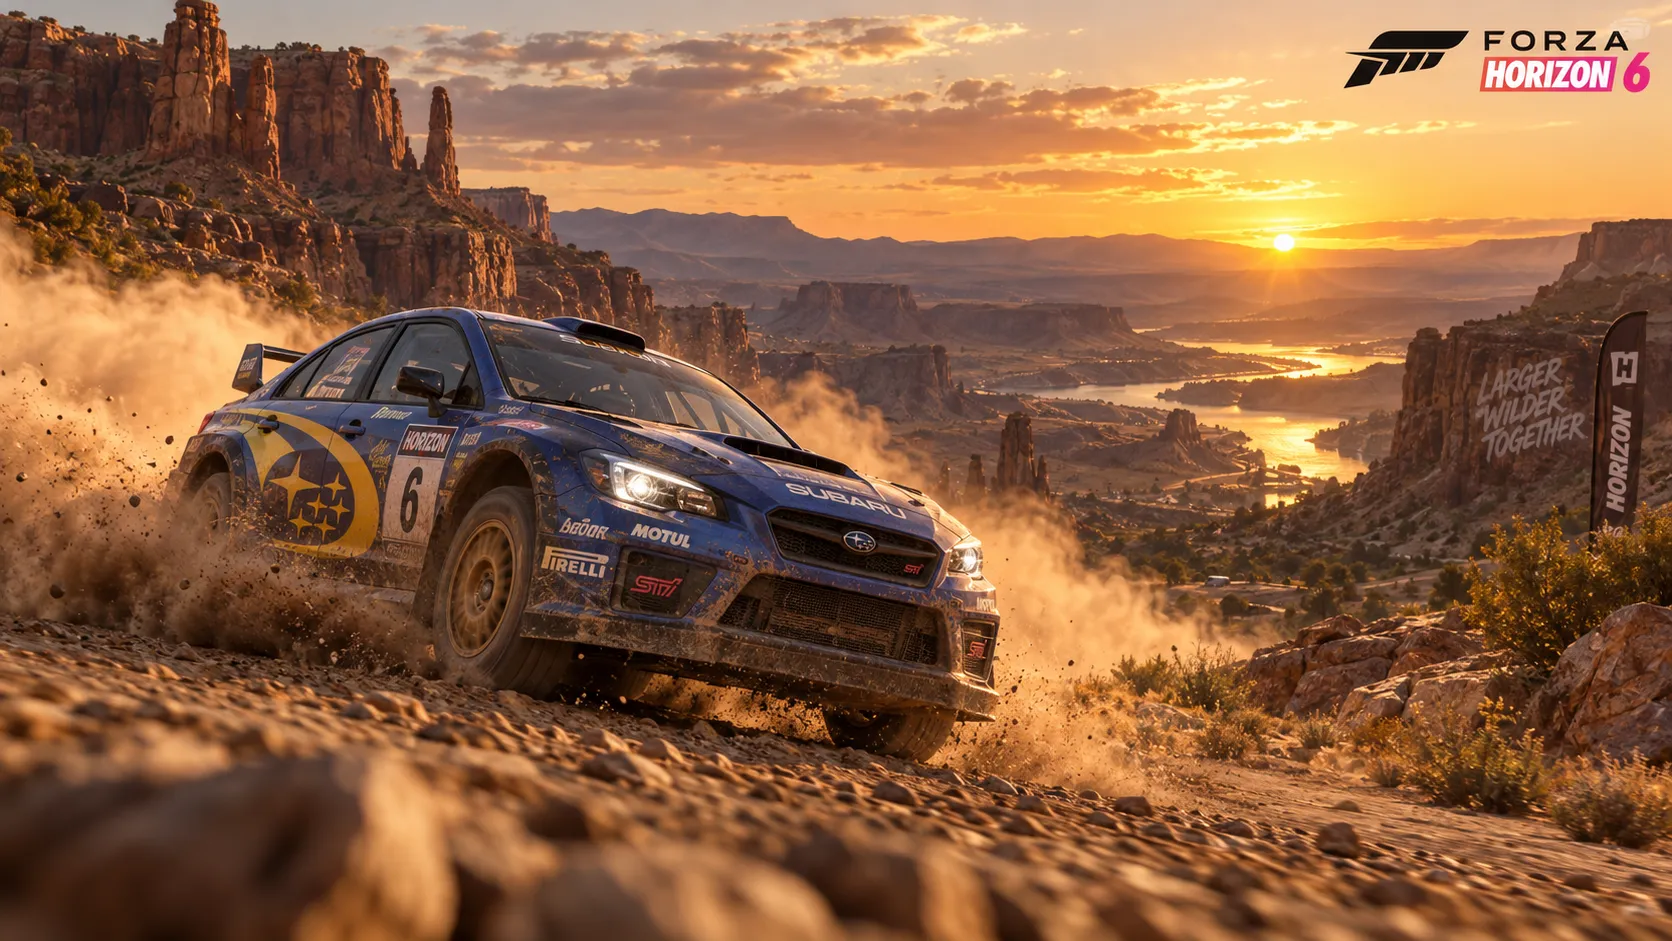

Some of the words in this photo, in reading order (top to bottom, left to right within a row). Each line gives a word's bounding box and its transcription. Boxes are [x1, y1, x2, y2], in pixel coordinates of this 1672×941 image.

[1476, 357, 1563, 406] LARGER
[1475, 386, 1568, 432] WILDER
[402, 430, 451, 453] HORIZON
[1481, 412, 1586, 463] TOGETHER
[1606, 405, 1632, 513] HORIZON
[400, 466, 424, 534] 6
[785, 482, 907, 520] SUBARU
[630, 523, 691, 549] MOTUL
[541, 545, 610, 579] PIRELLI
